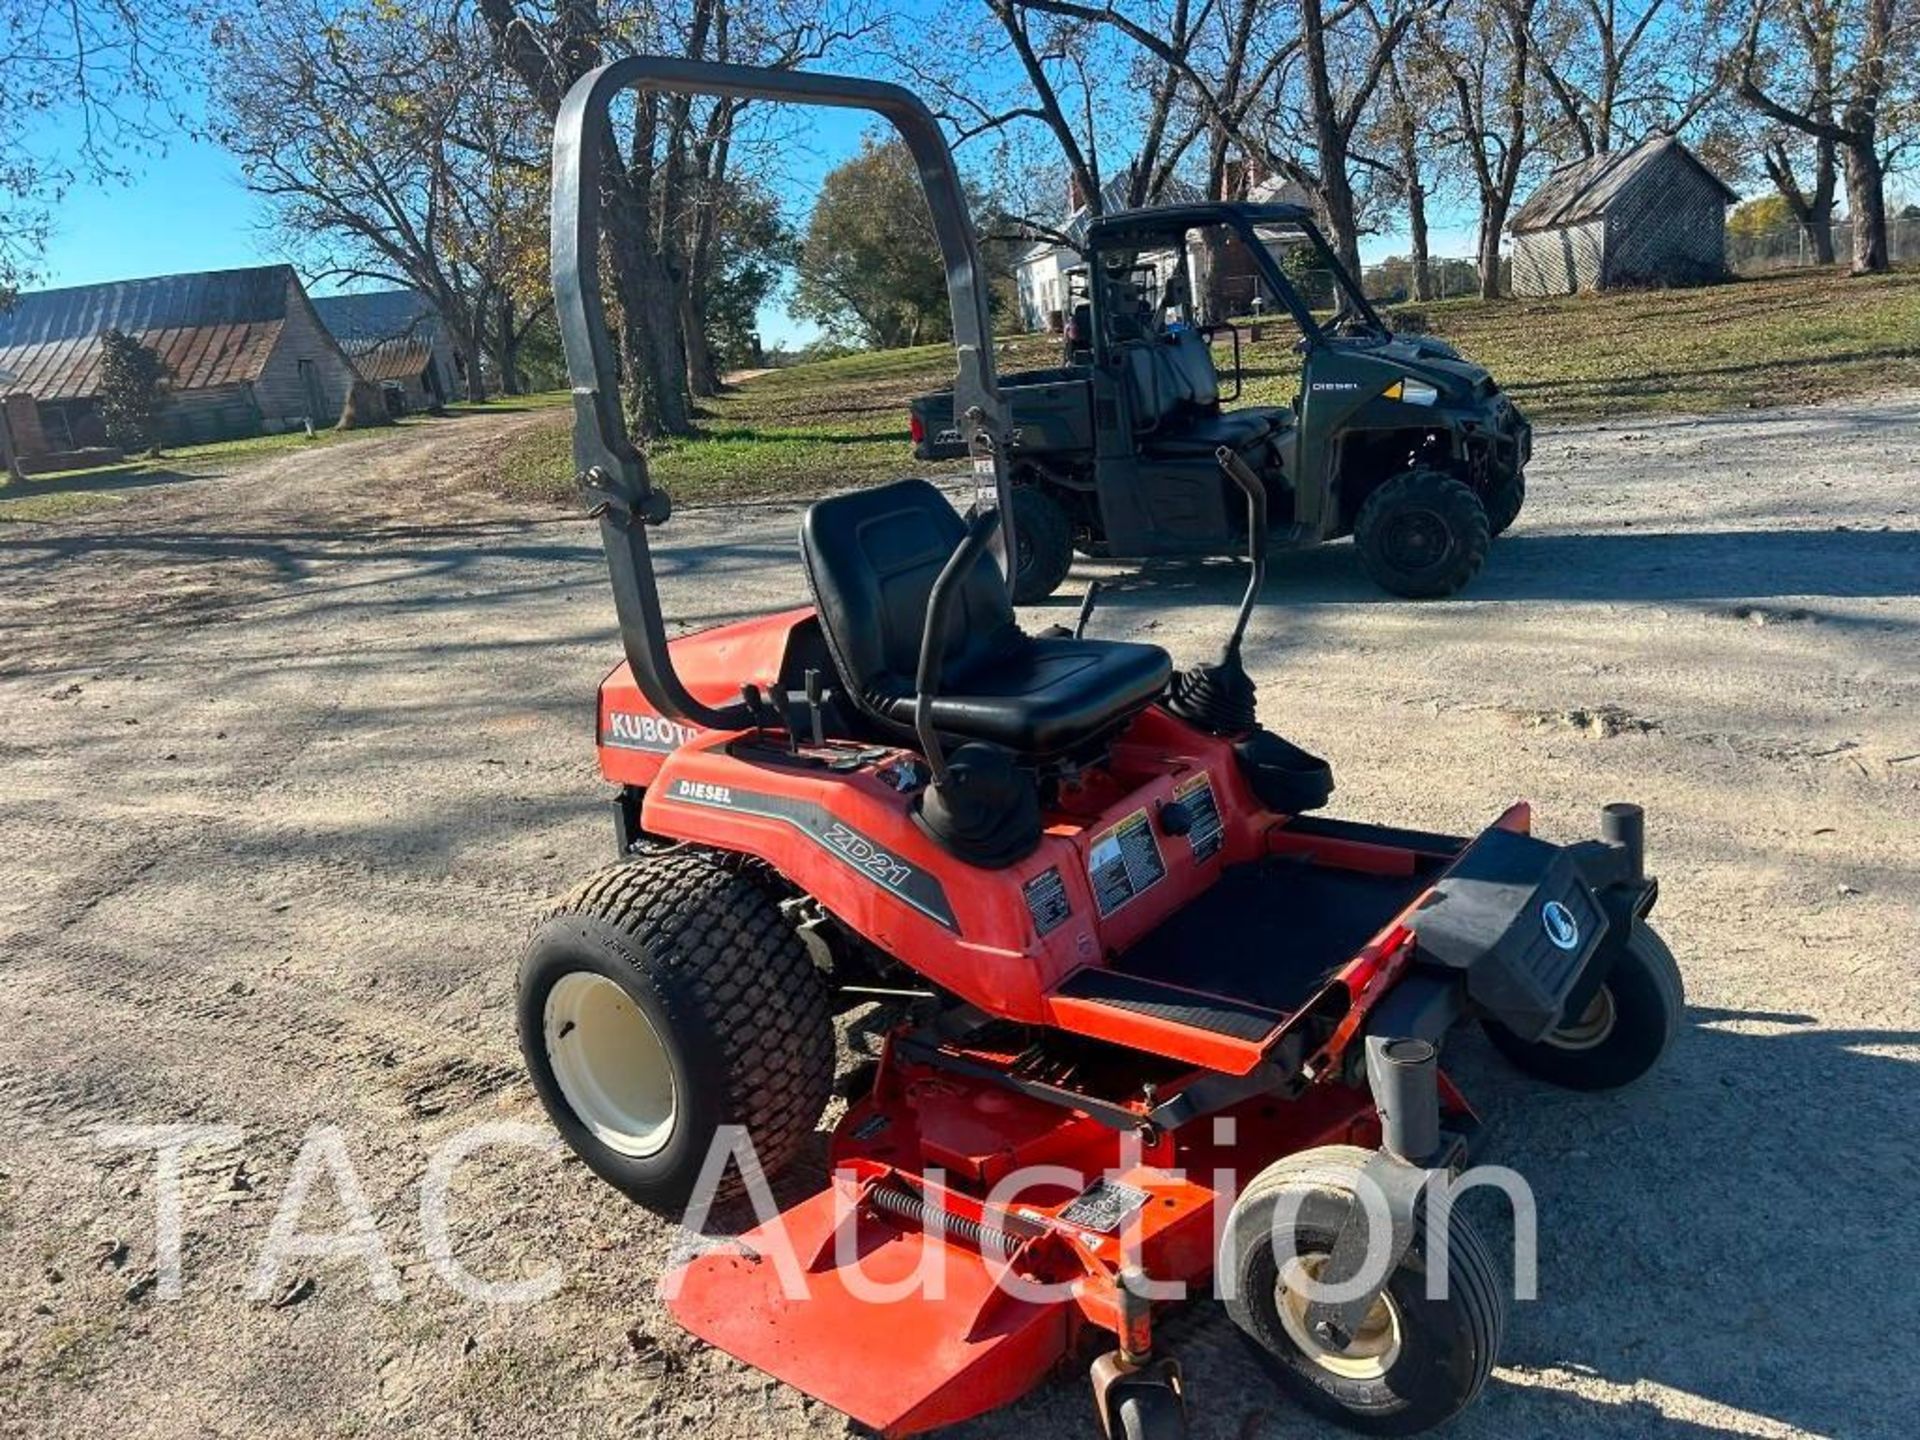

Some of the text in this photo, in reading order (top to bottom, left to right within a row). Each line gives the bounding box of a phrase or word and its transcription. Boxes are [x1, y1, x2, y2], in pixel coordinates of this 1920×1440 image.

[1312, 383, 1360, 391] DIESEL
[679, 780, 732, 804] DIESEL
[823, 823, 912, 886] ZD21
